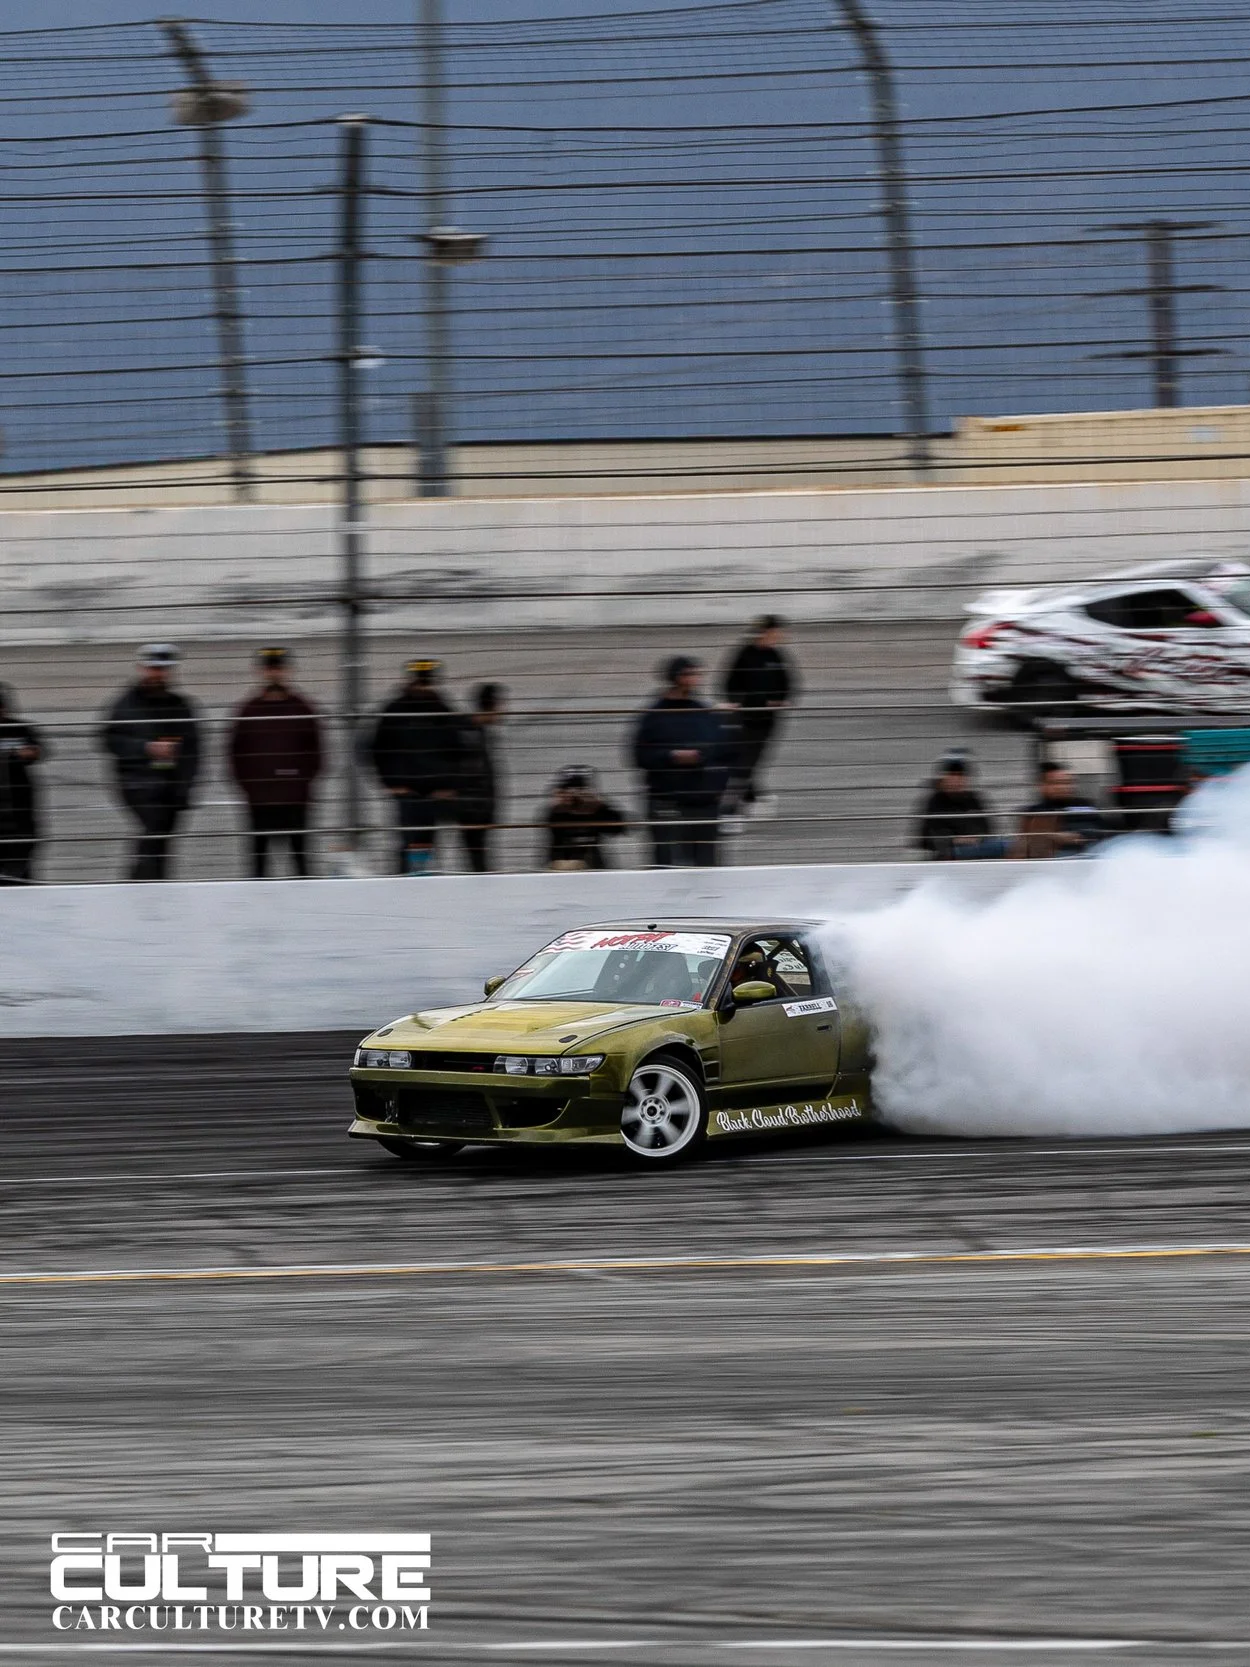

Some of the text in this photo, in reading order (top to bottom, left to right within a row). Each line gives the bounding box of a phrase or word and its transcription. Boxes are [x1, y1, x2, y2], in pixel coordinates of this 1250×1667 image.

[716, 1098, 861, 1131] Black Cloud Brotherhood
